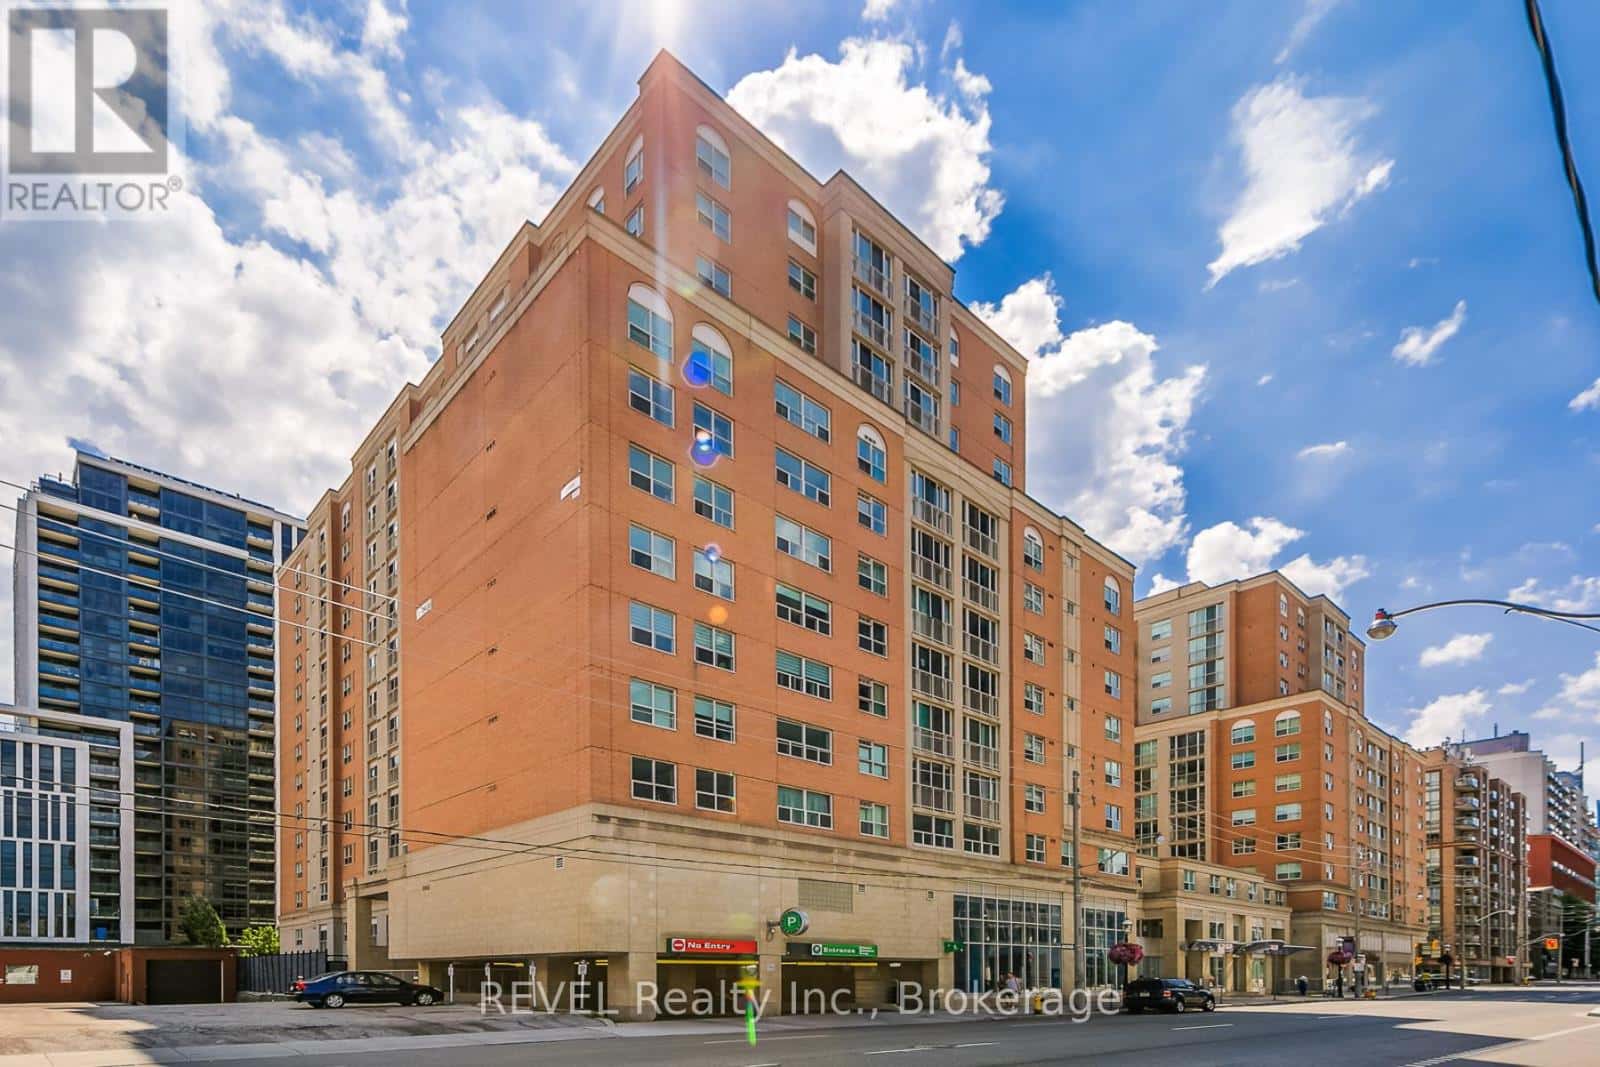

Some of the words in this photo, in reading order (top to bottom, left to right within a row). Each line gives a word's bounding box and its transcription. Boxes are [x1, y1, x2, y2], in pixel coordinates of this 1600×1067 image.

[787, 916, 797, 927] P
[687, 941, 702, 949] No
[703, 942, 731, 951] Entry
[823, 946, 856, 954] Entrance
